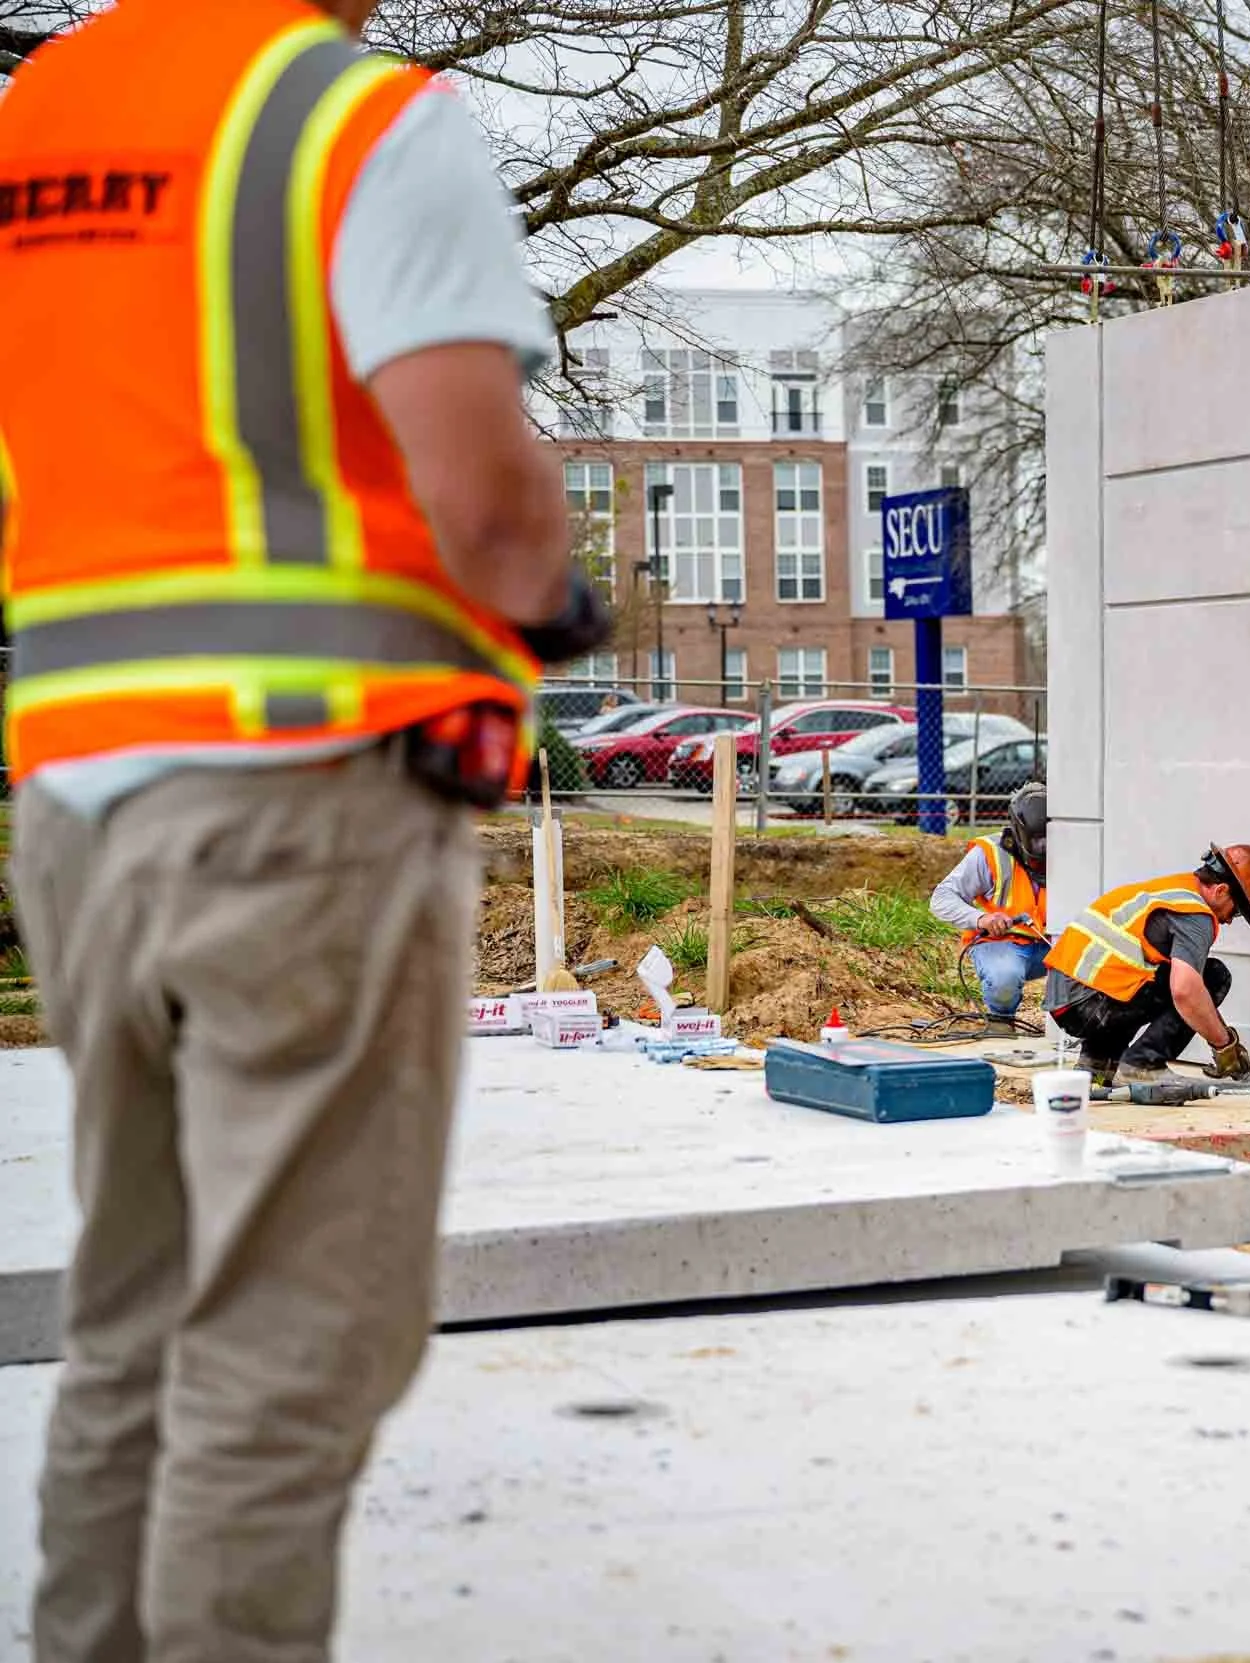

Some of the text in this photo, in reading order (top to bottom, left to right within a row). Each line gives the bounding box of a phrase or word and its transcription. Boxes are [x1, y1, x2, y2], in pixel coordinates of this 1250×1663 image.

[887, 504, 943, 558] SECU
[469, 1003, 506, 1020] ej-it
[676, 1019, 714, 1031] wej-it
